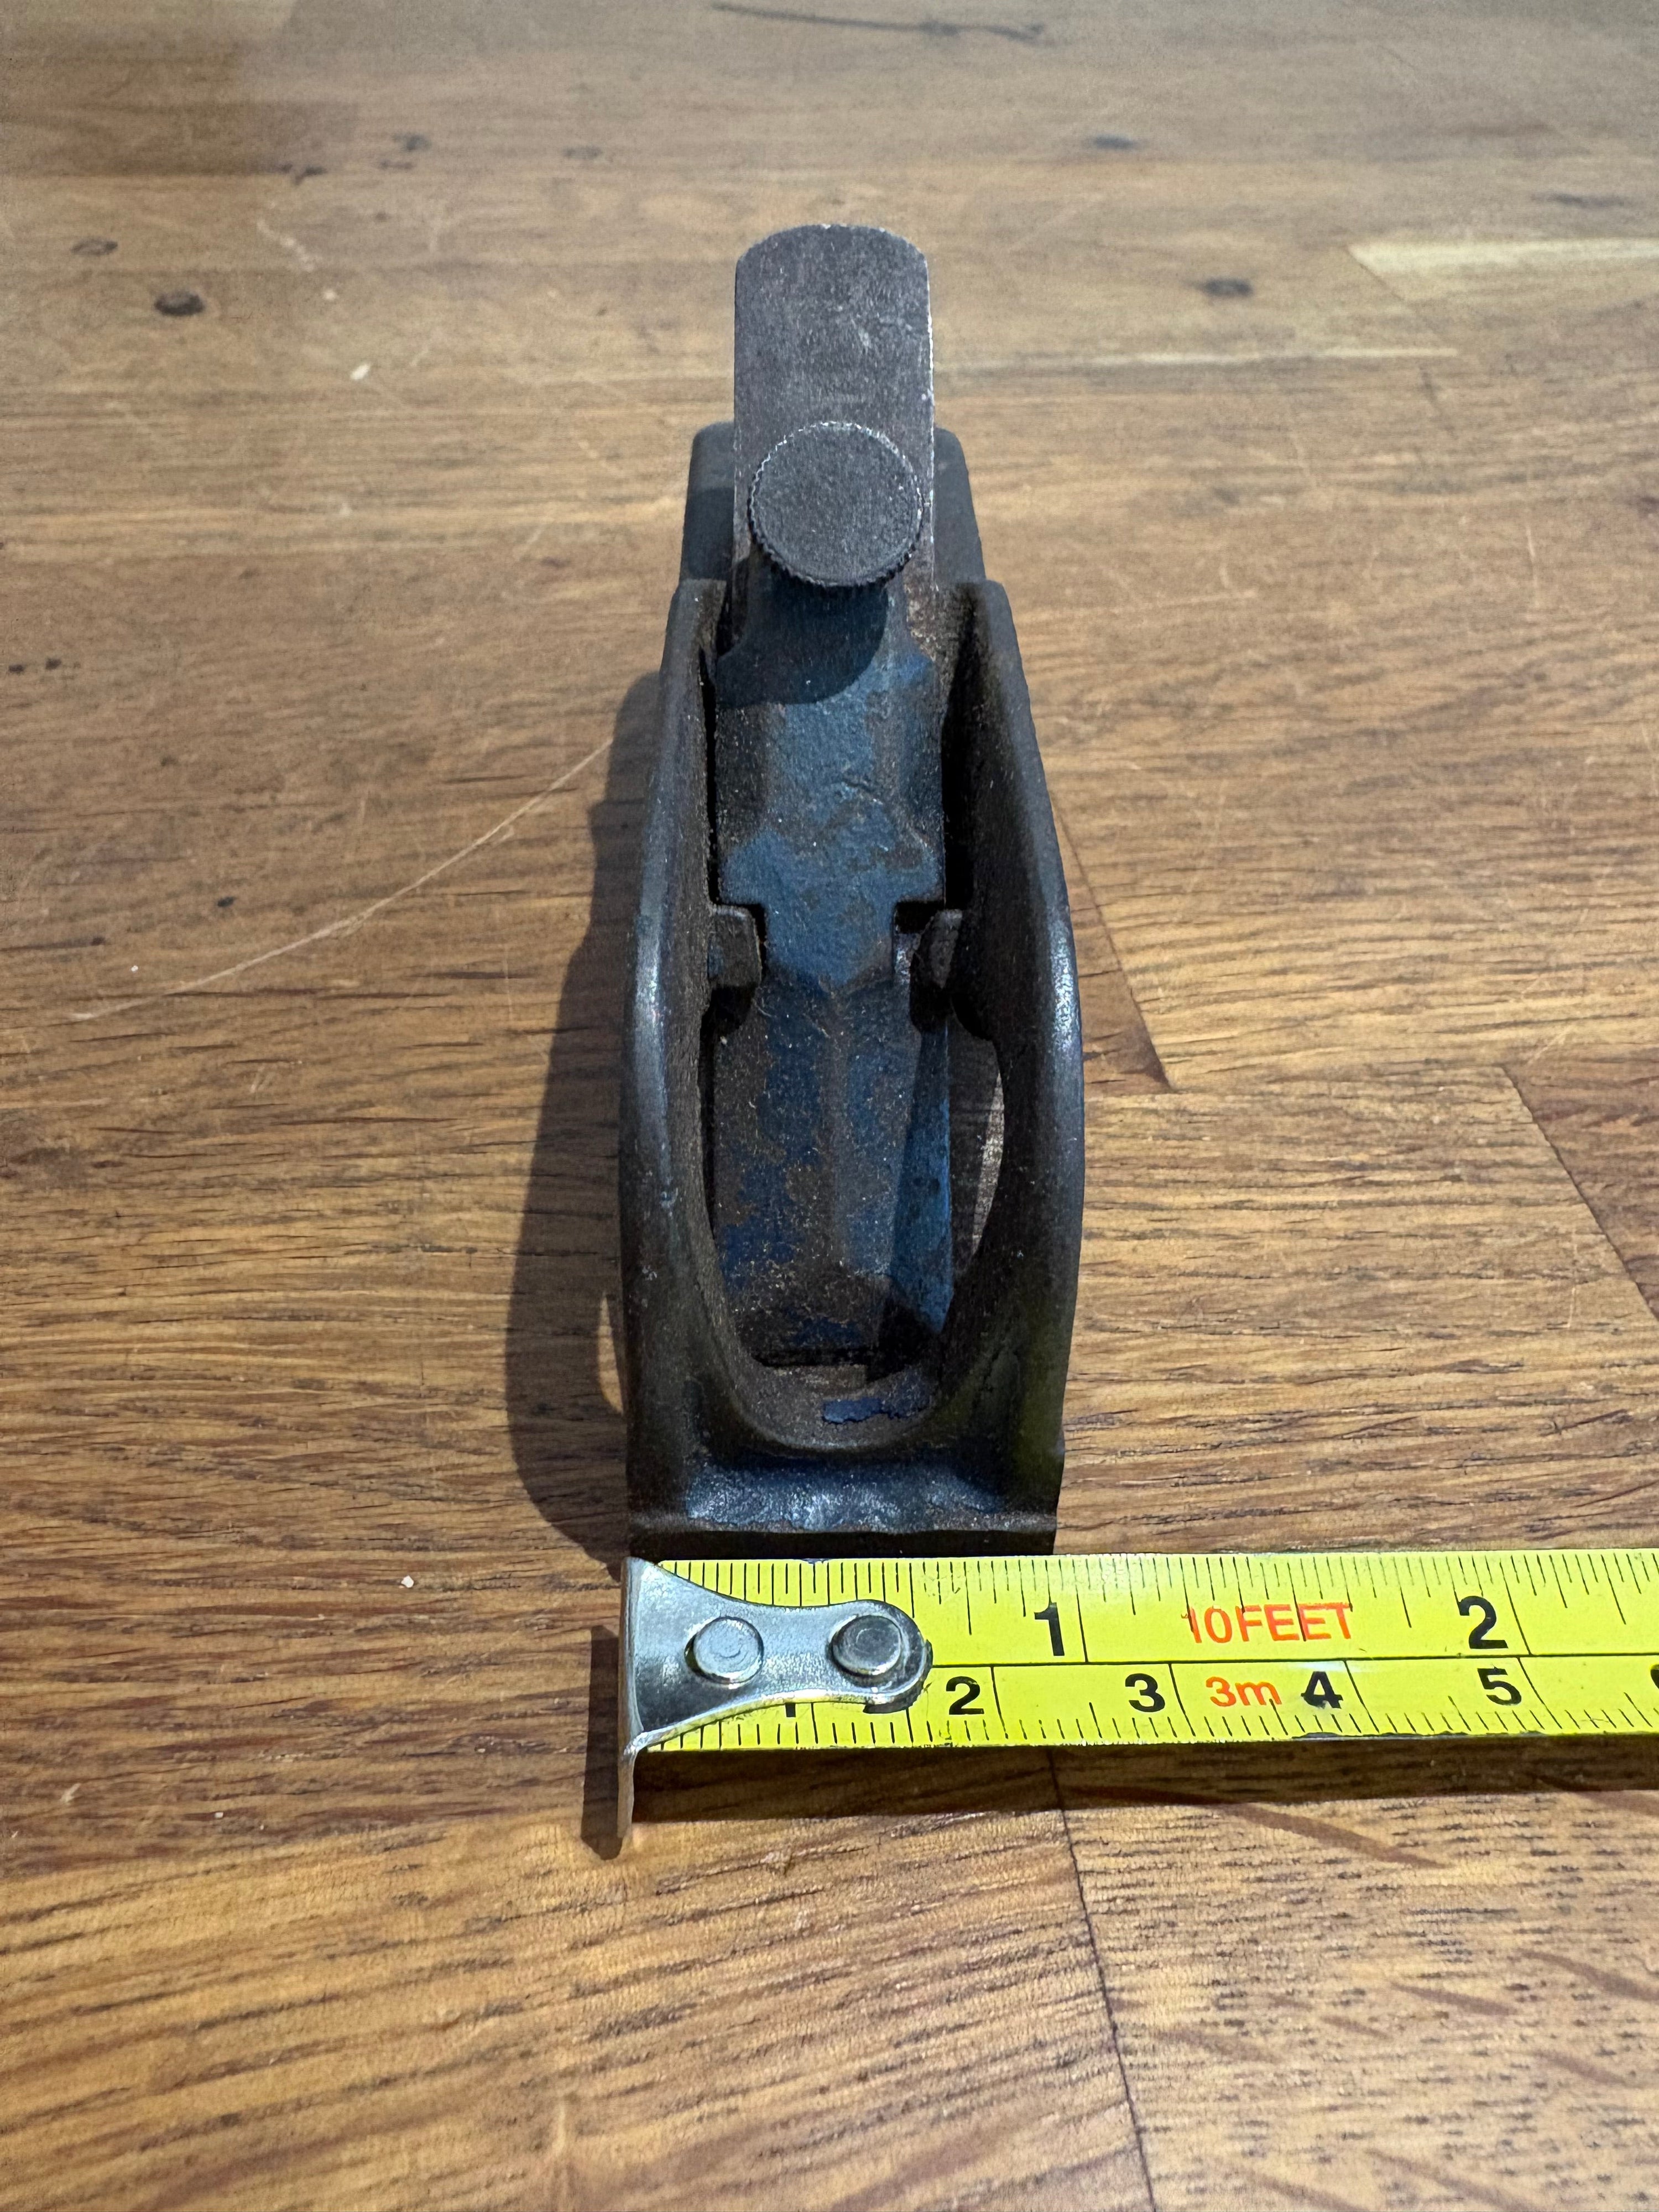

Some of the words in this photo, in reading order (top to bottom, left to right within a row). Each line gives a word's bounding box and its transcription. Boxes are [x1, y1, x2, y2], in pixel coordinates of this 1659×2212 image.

[1034, 1602, 1065, 1656] 1
[1458, 1595, 1508, 1650] 2
[945, 1676, 984, 1715] 2
[1124, 1673, 1166, 1713] 3
[1204, 1676, 1281, 1707] 3m
[1300, 1671, 1343, 1709] 4
[1477, 1667, 1522, 1706] 5
